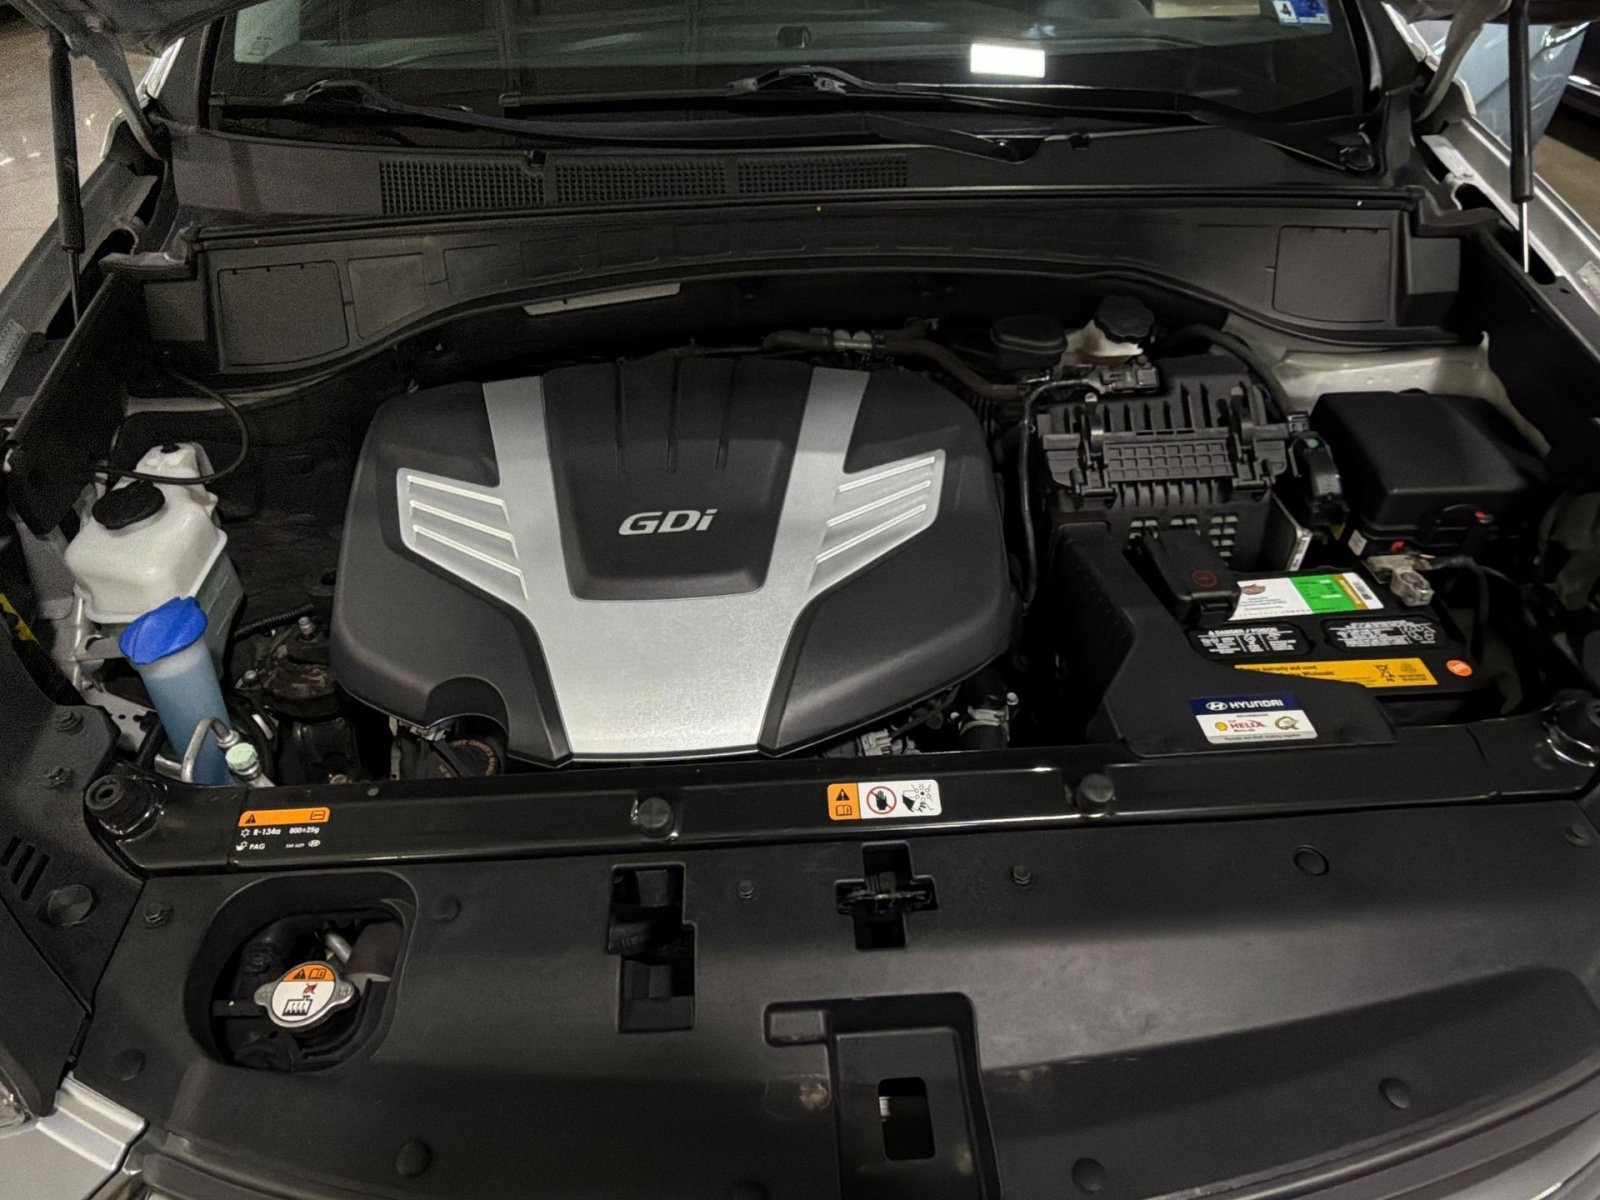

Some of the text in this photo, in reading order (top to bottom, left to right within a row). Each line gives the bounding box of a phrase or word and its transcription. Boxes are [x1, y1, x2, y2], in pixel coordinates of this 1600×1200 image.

[618, 508, 718, 536] GDi
[1229, 699, 1285, 710] HYUNDAI
[1230, 720, 1266, 729] HELIX
[253, 828, 281, 836] R-134a
